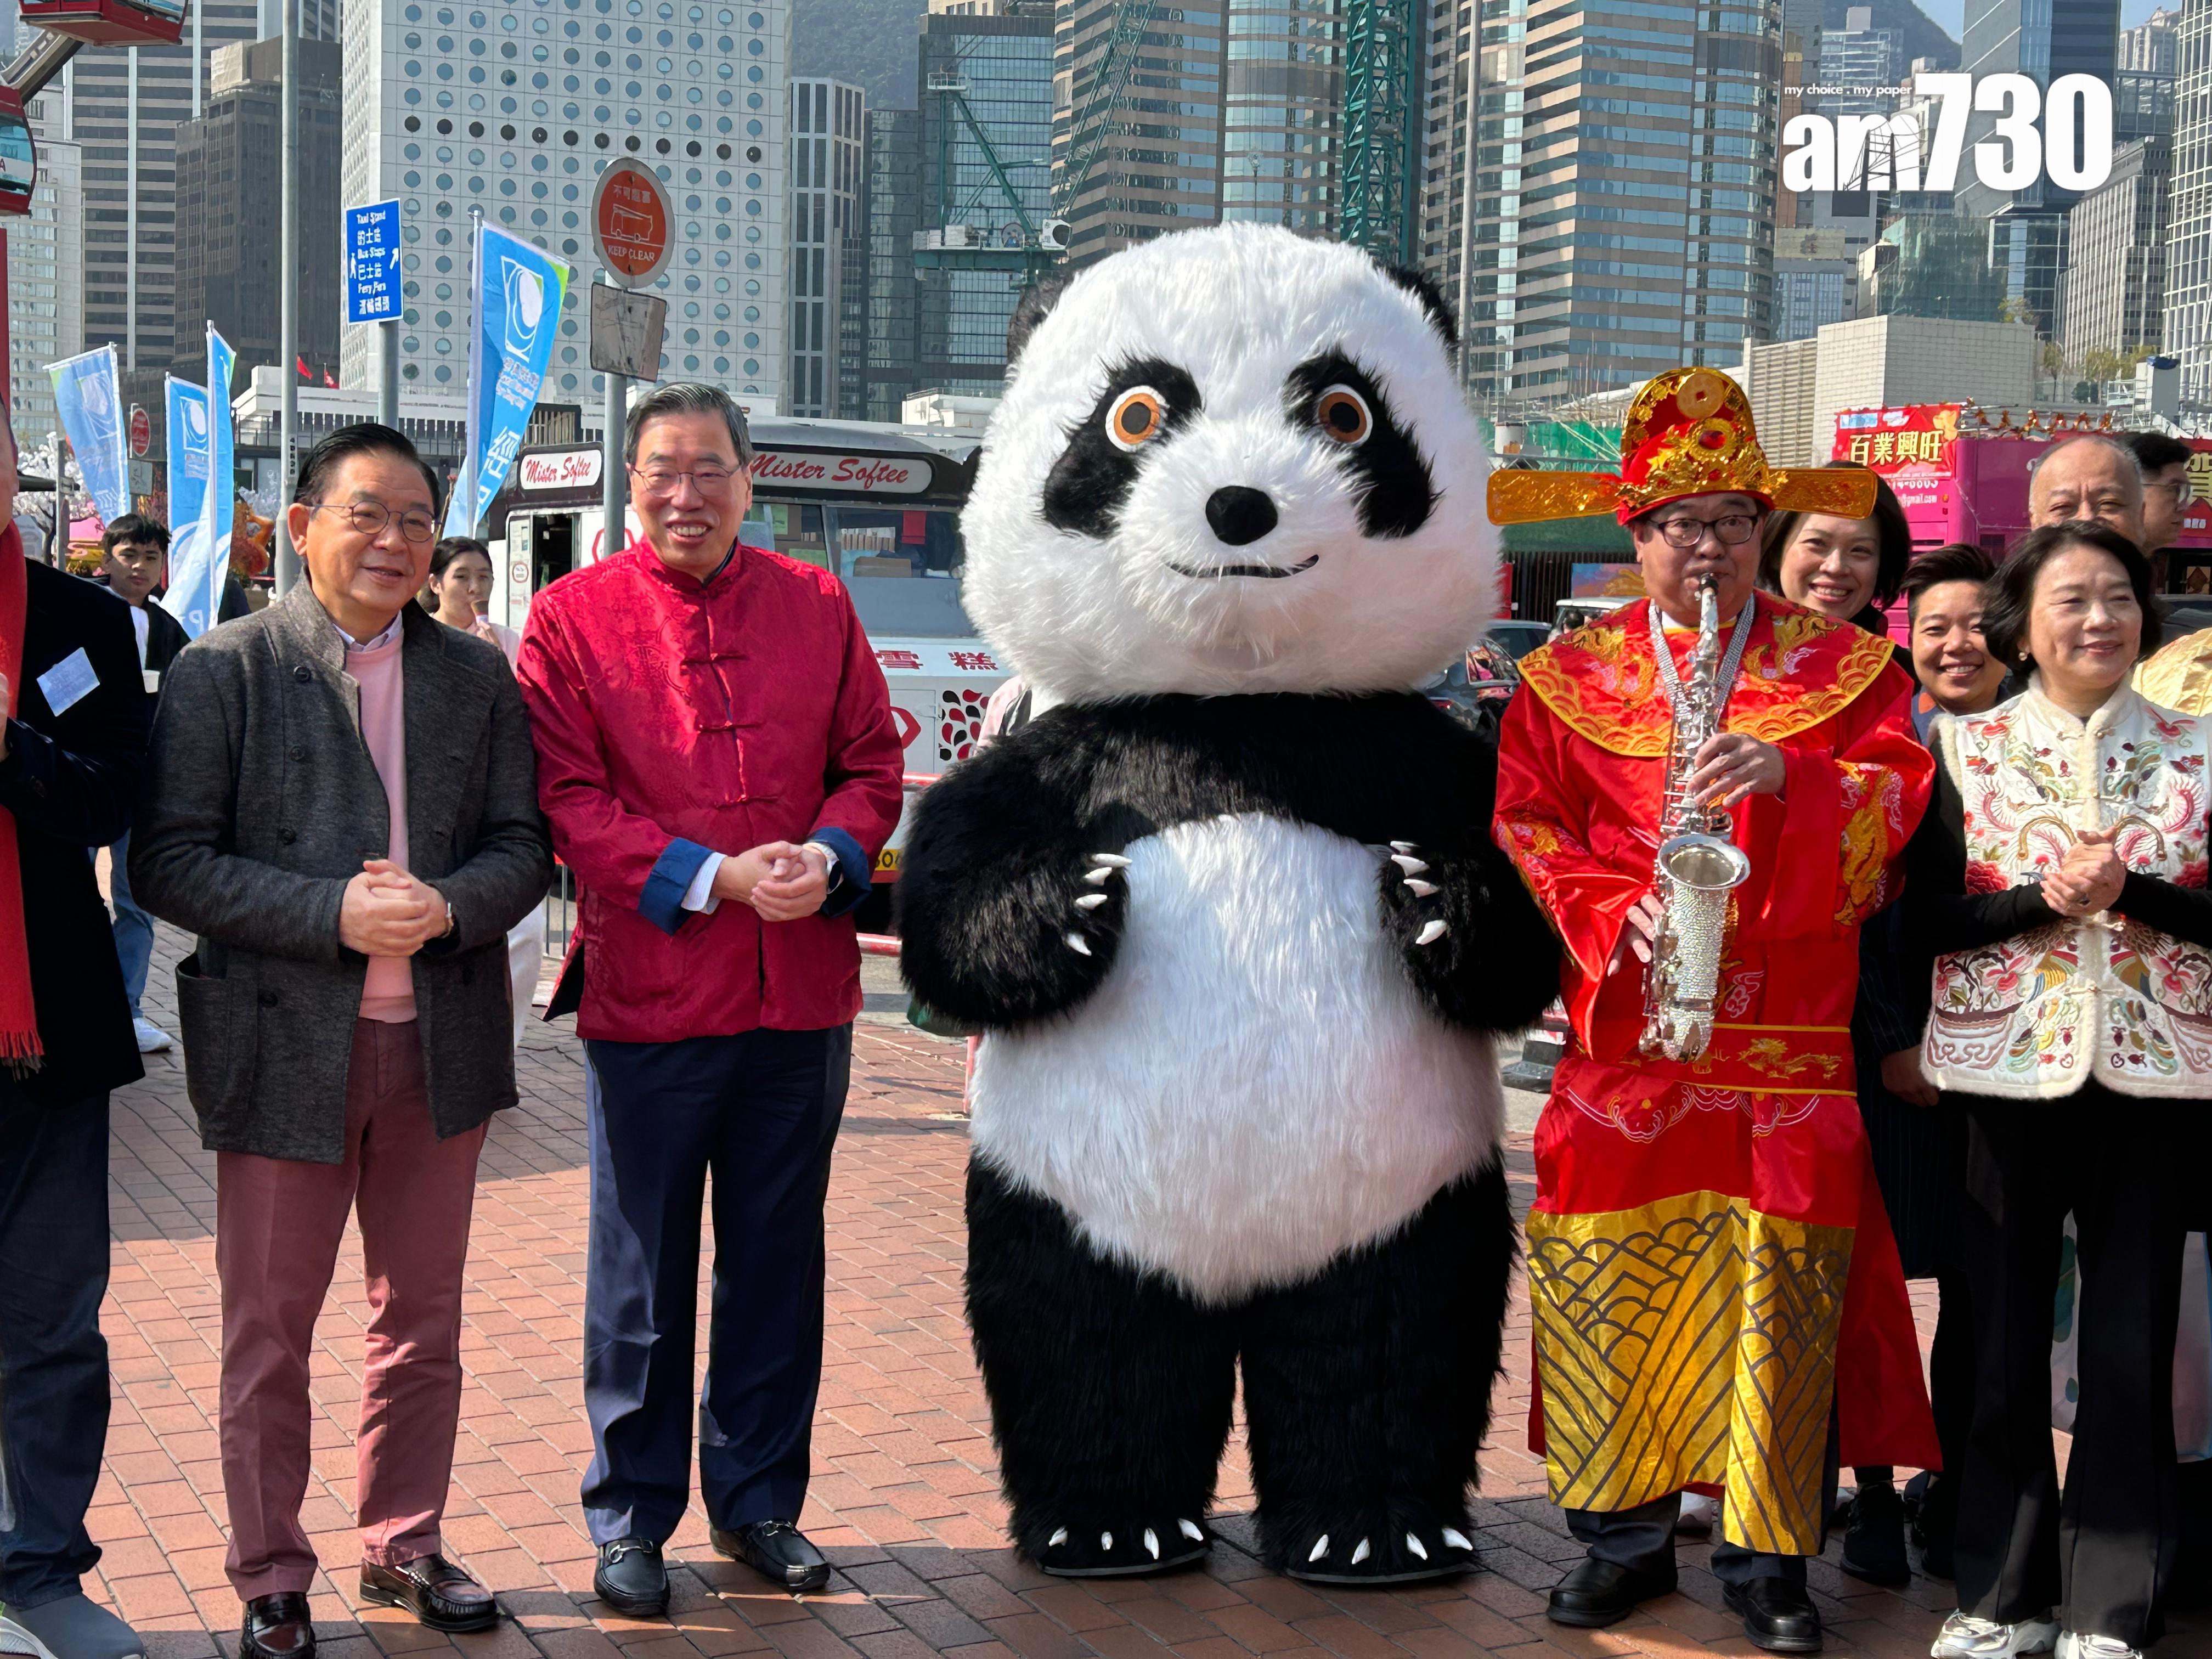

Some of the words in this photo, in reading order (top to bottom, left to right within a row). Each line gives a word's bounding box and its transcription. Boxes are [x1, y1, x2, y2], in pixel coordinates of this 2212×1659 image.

[608, 245, 627, 257] KEEP
[628, 247, 655, 262] CLEAR
[1849, 430, 1944, 466] 百業興旺
[526, 459, 557, 483] Mister
[561, 455, 591, 487] Softee
[831, 459, 909, 490] Softee
